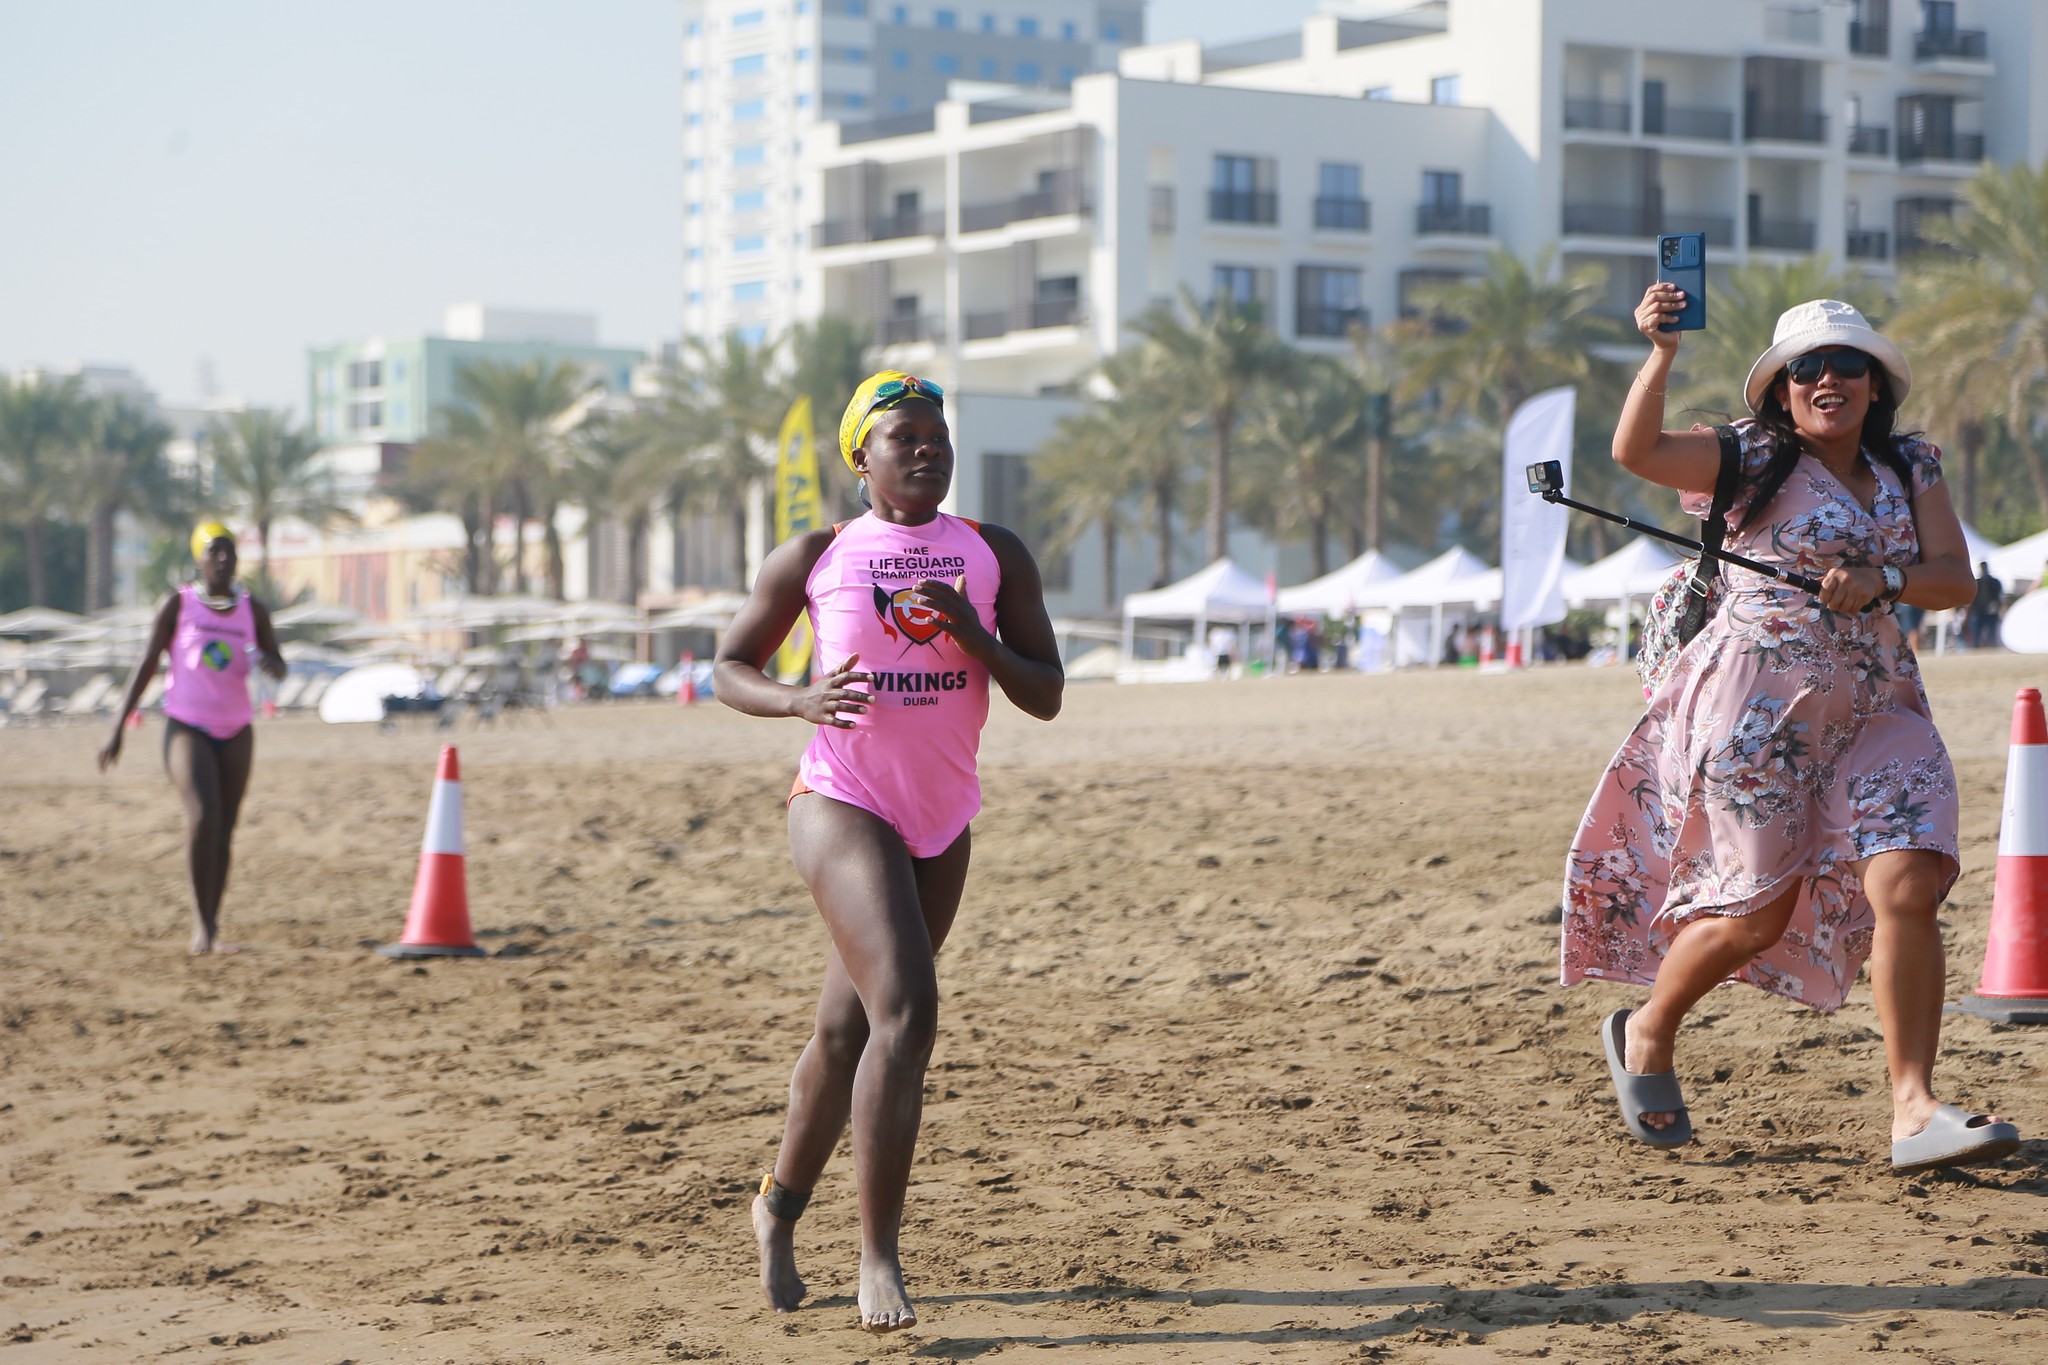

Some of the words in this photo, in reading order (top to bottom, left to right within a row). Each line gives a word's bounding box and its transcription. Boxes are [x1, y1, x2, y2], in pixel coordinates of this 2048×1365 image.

[903, 546, 930, 556] UAE
[869, 556, 965, 570] LIFEGUARD
[871, 568, 965, 580] CHAMPIONSHIP
[871, 671, 967, 693] VIKINGS
[903, 696, 938, 707] DUBAI
